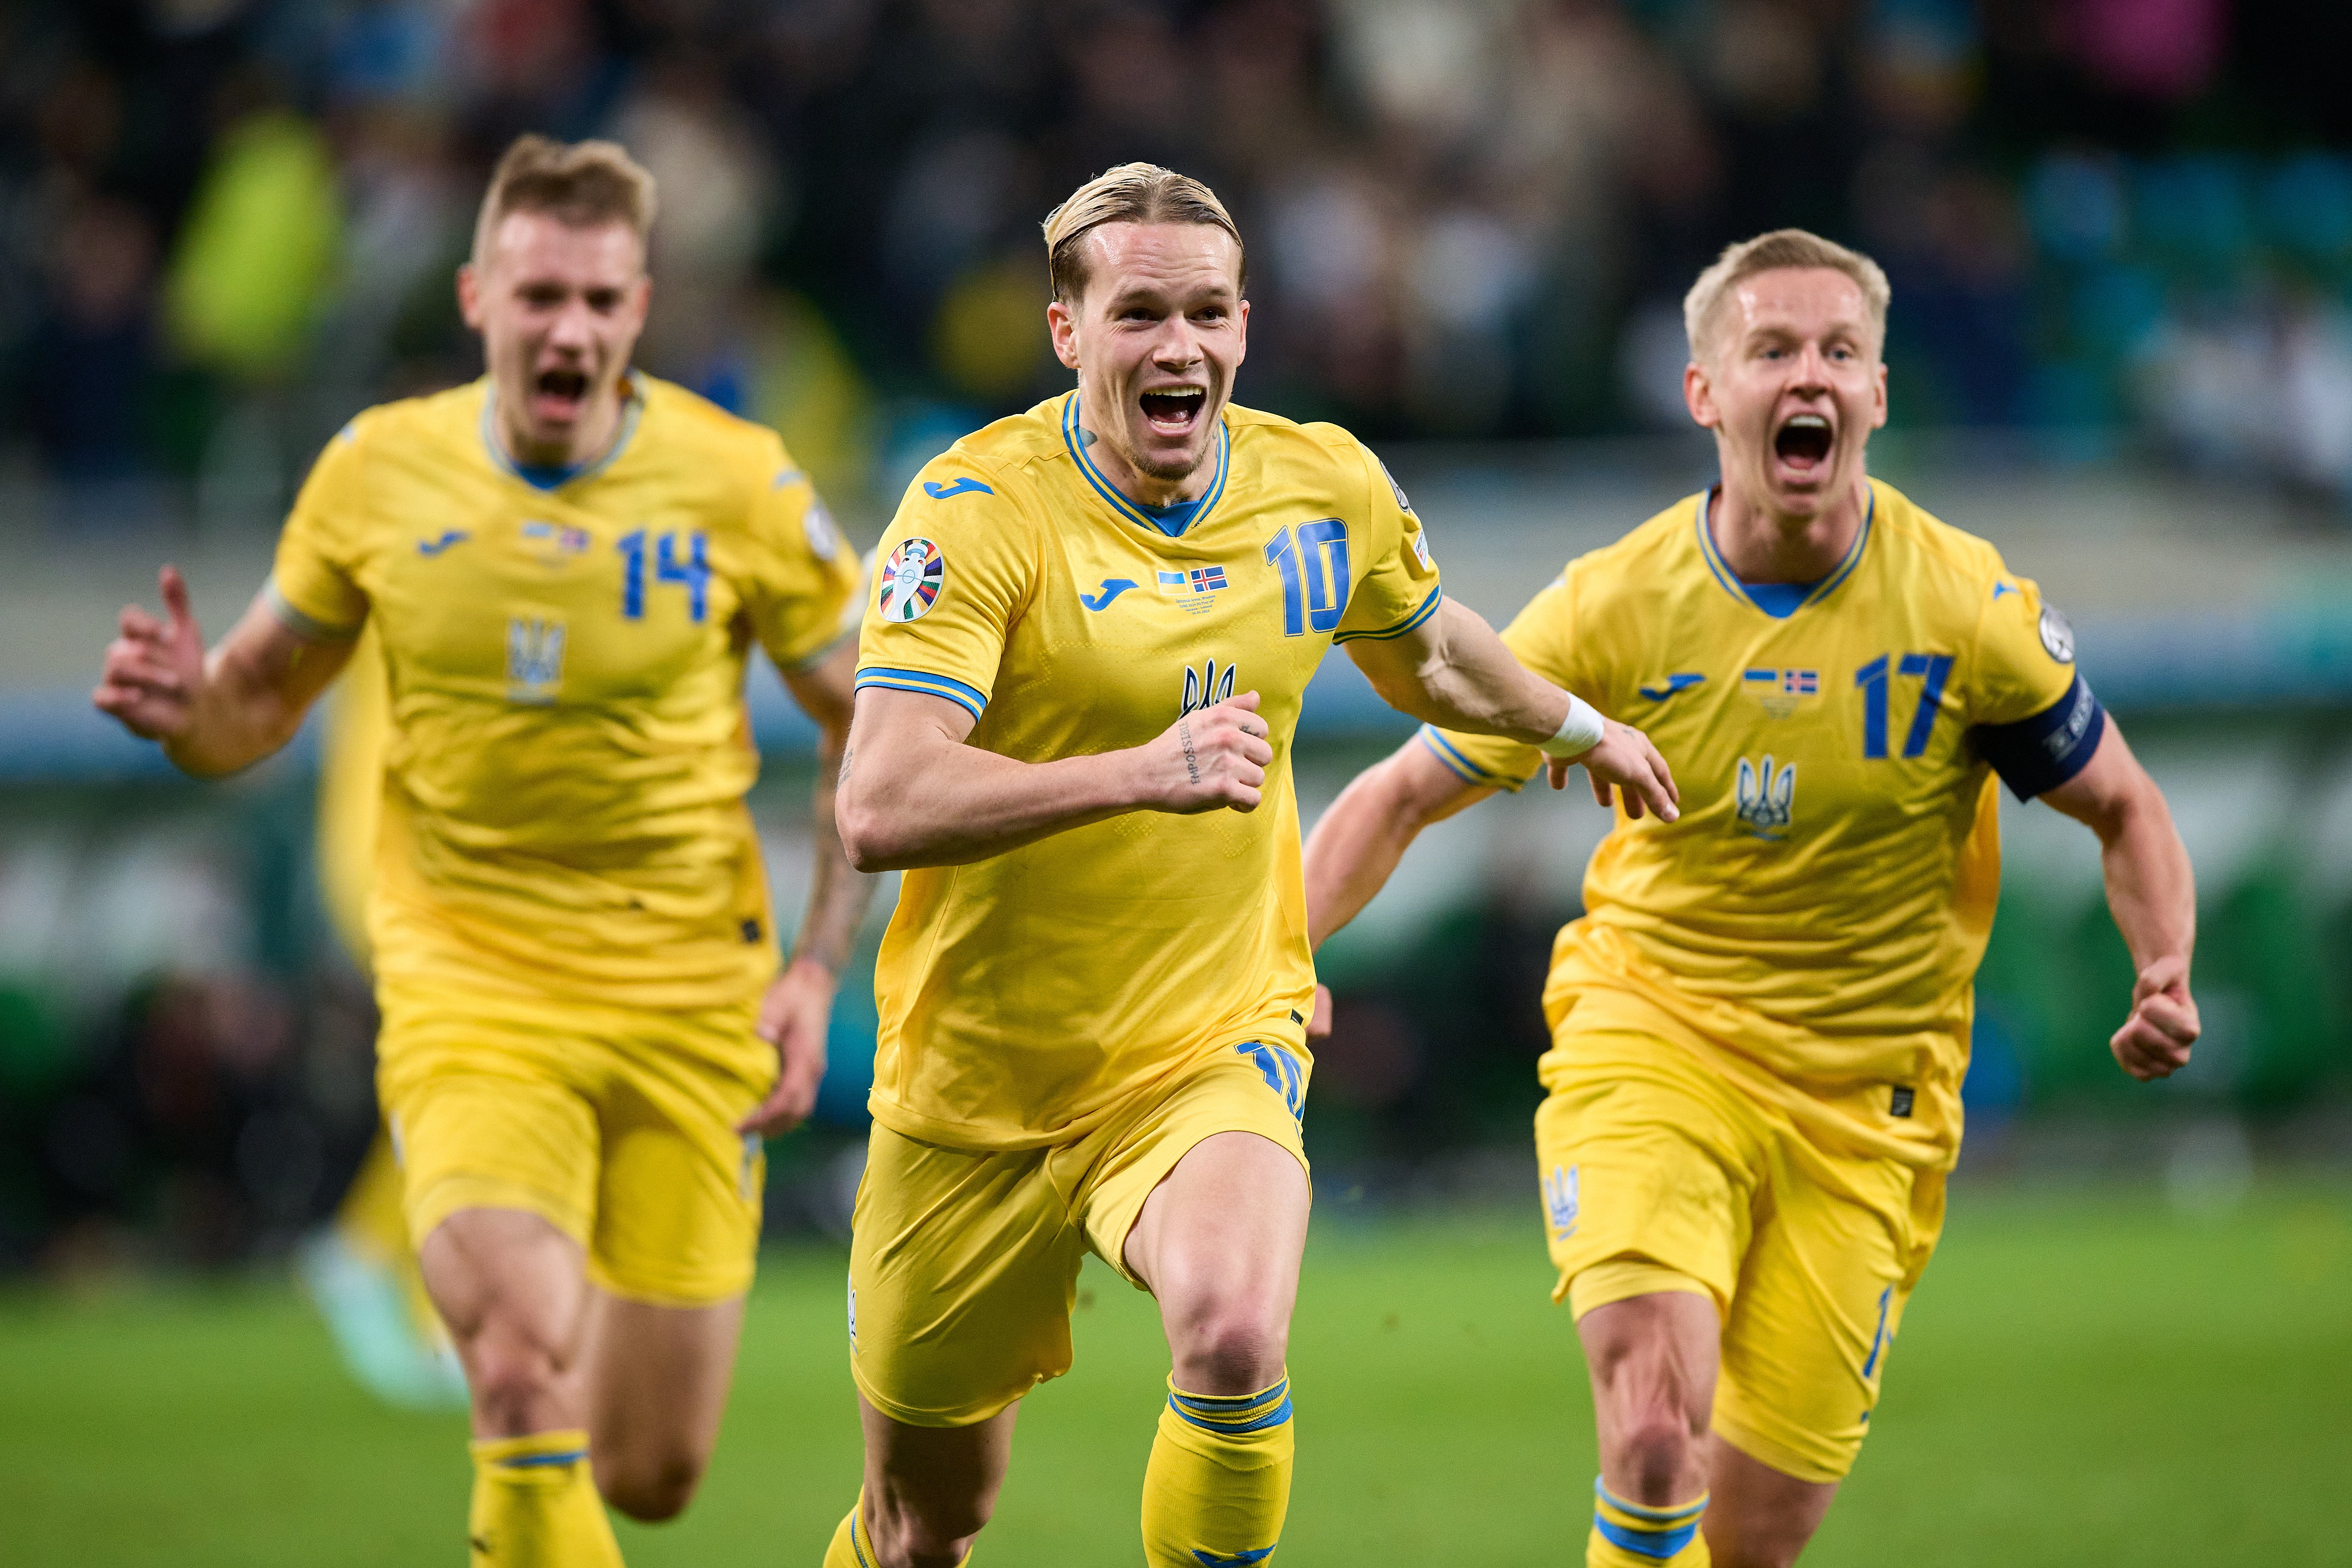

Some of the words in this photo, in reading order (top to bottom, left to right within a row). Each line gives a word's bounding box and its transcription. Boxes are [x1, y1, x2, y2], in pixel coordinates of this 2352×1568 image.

[616, 528, 711, 622] 14
[1264, 517, 1351, 637] 10
[1854, 653, 1956, 759] 17
